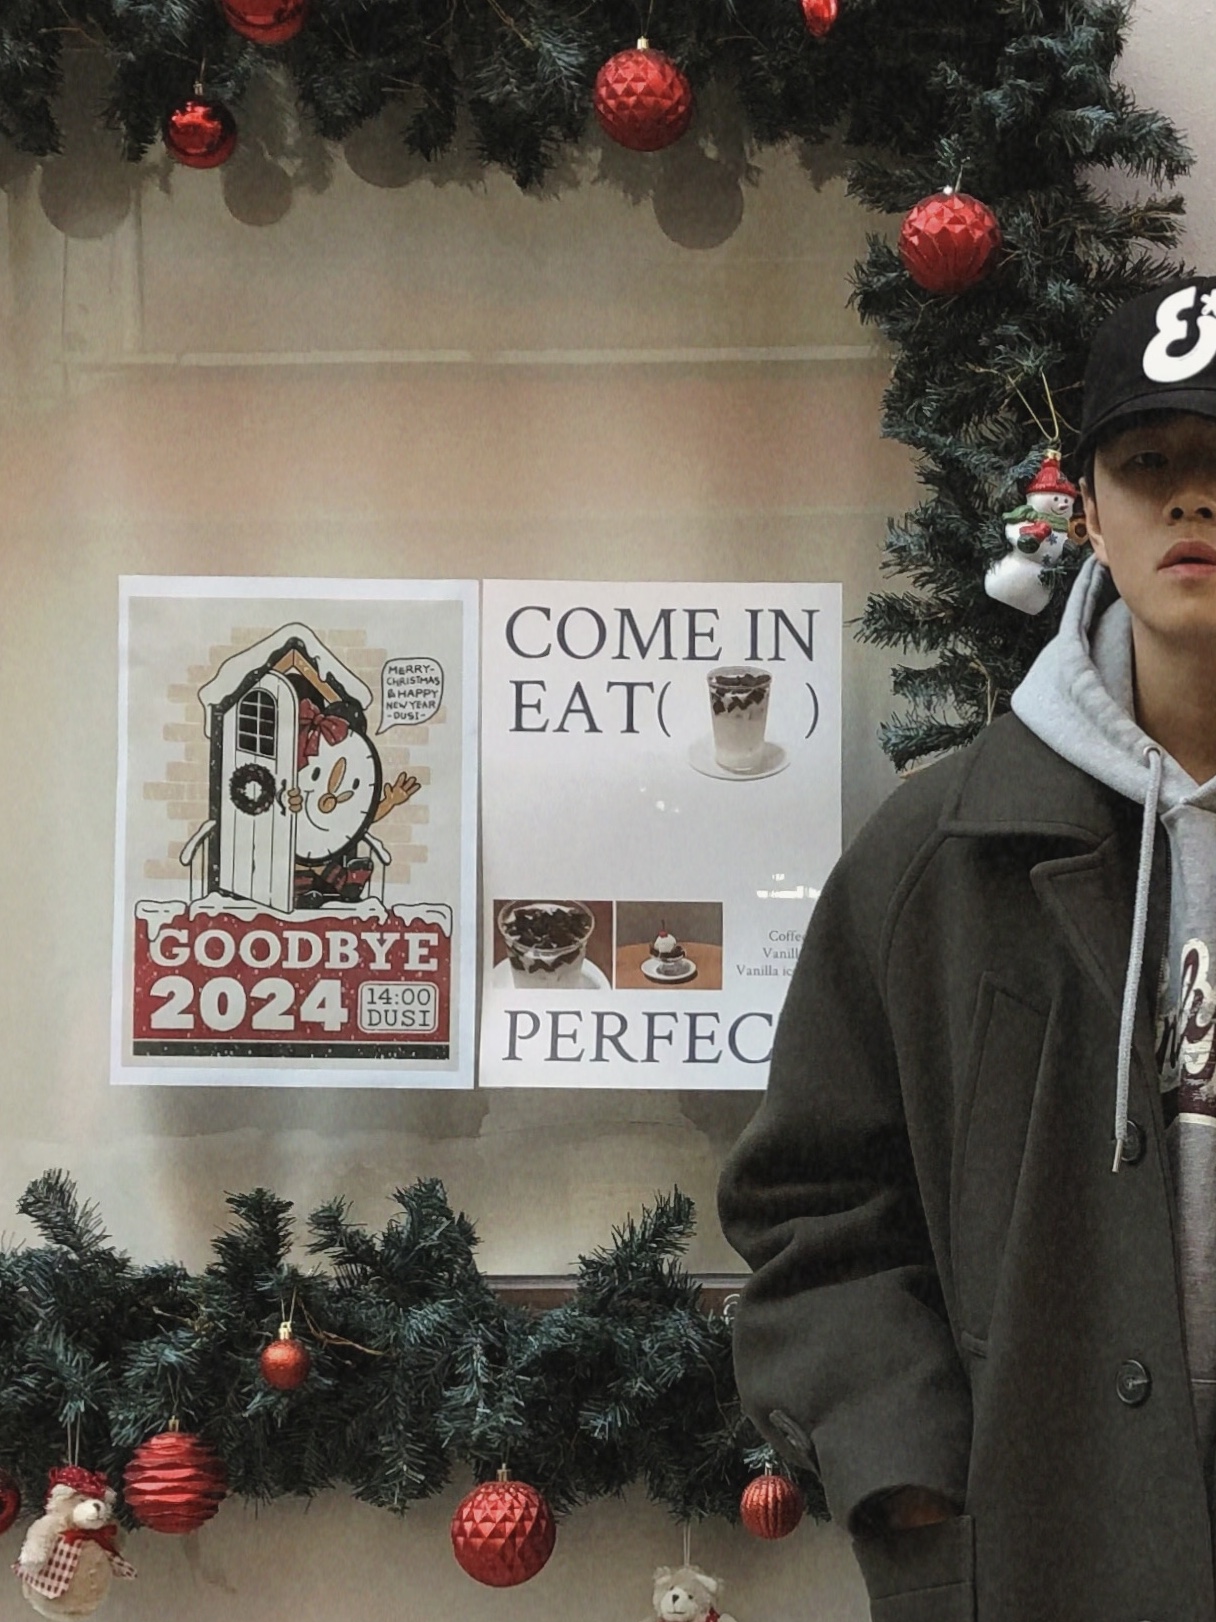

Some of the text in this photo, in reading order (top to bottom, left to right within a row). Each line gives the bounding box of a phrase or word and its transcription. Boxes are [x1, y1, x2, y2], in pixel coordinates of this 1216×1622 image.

[505, 605, 820, 662] COME IN
[387, 676, 440, 686] CHRISTMAS
[398, 688, 439, 698] HAPPY
[386, 700, 436, 710] NEW YEAR
[149, 928, 439, 972] GOODBYE
[736, 964, 779, 977] Vanilla
[149, 974, 349, 1032] 2024
[366, 987, 431, 1006] 14:00
[366, 1008, 431, 1027] DUSI
